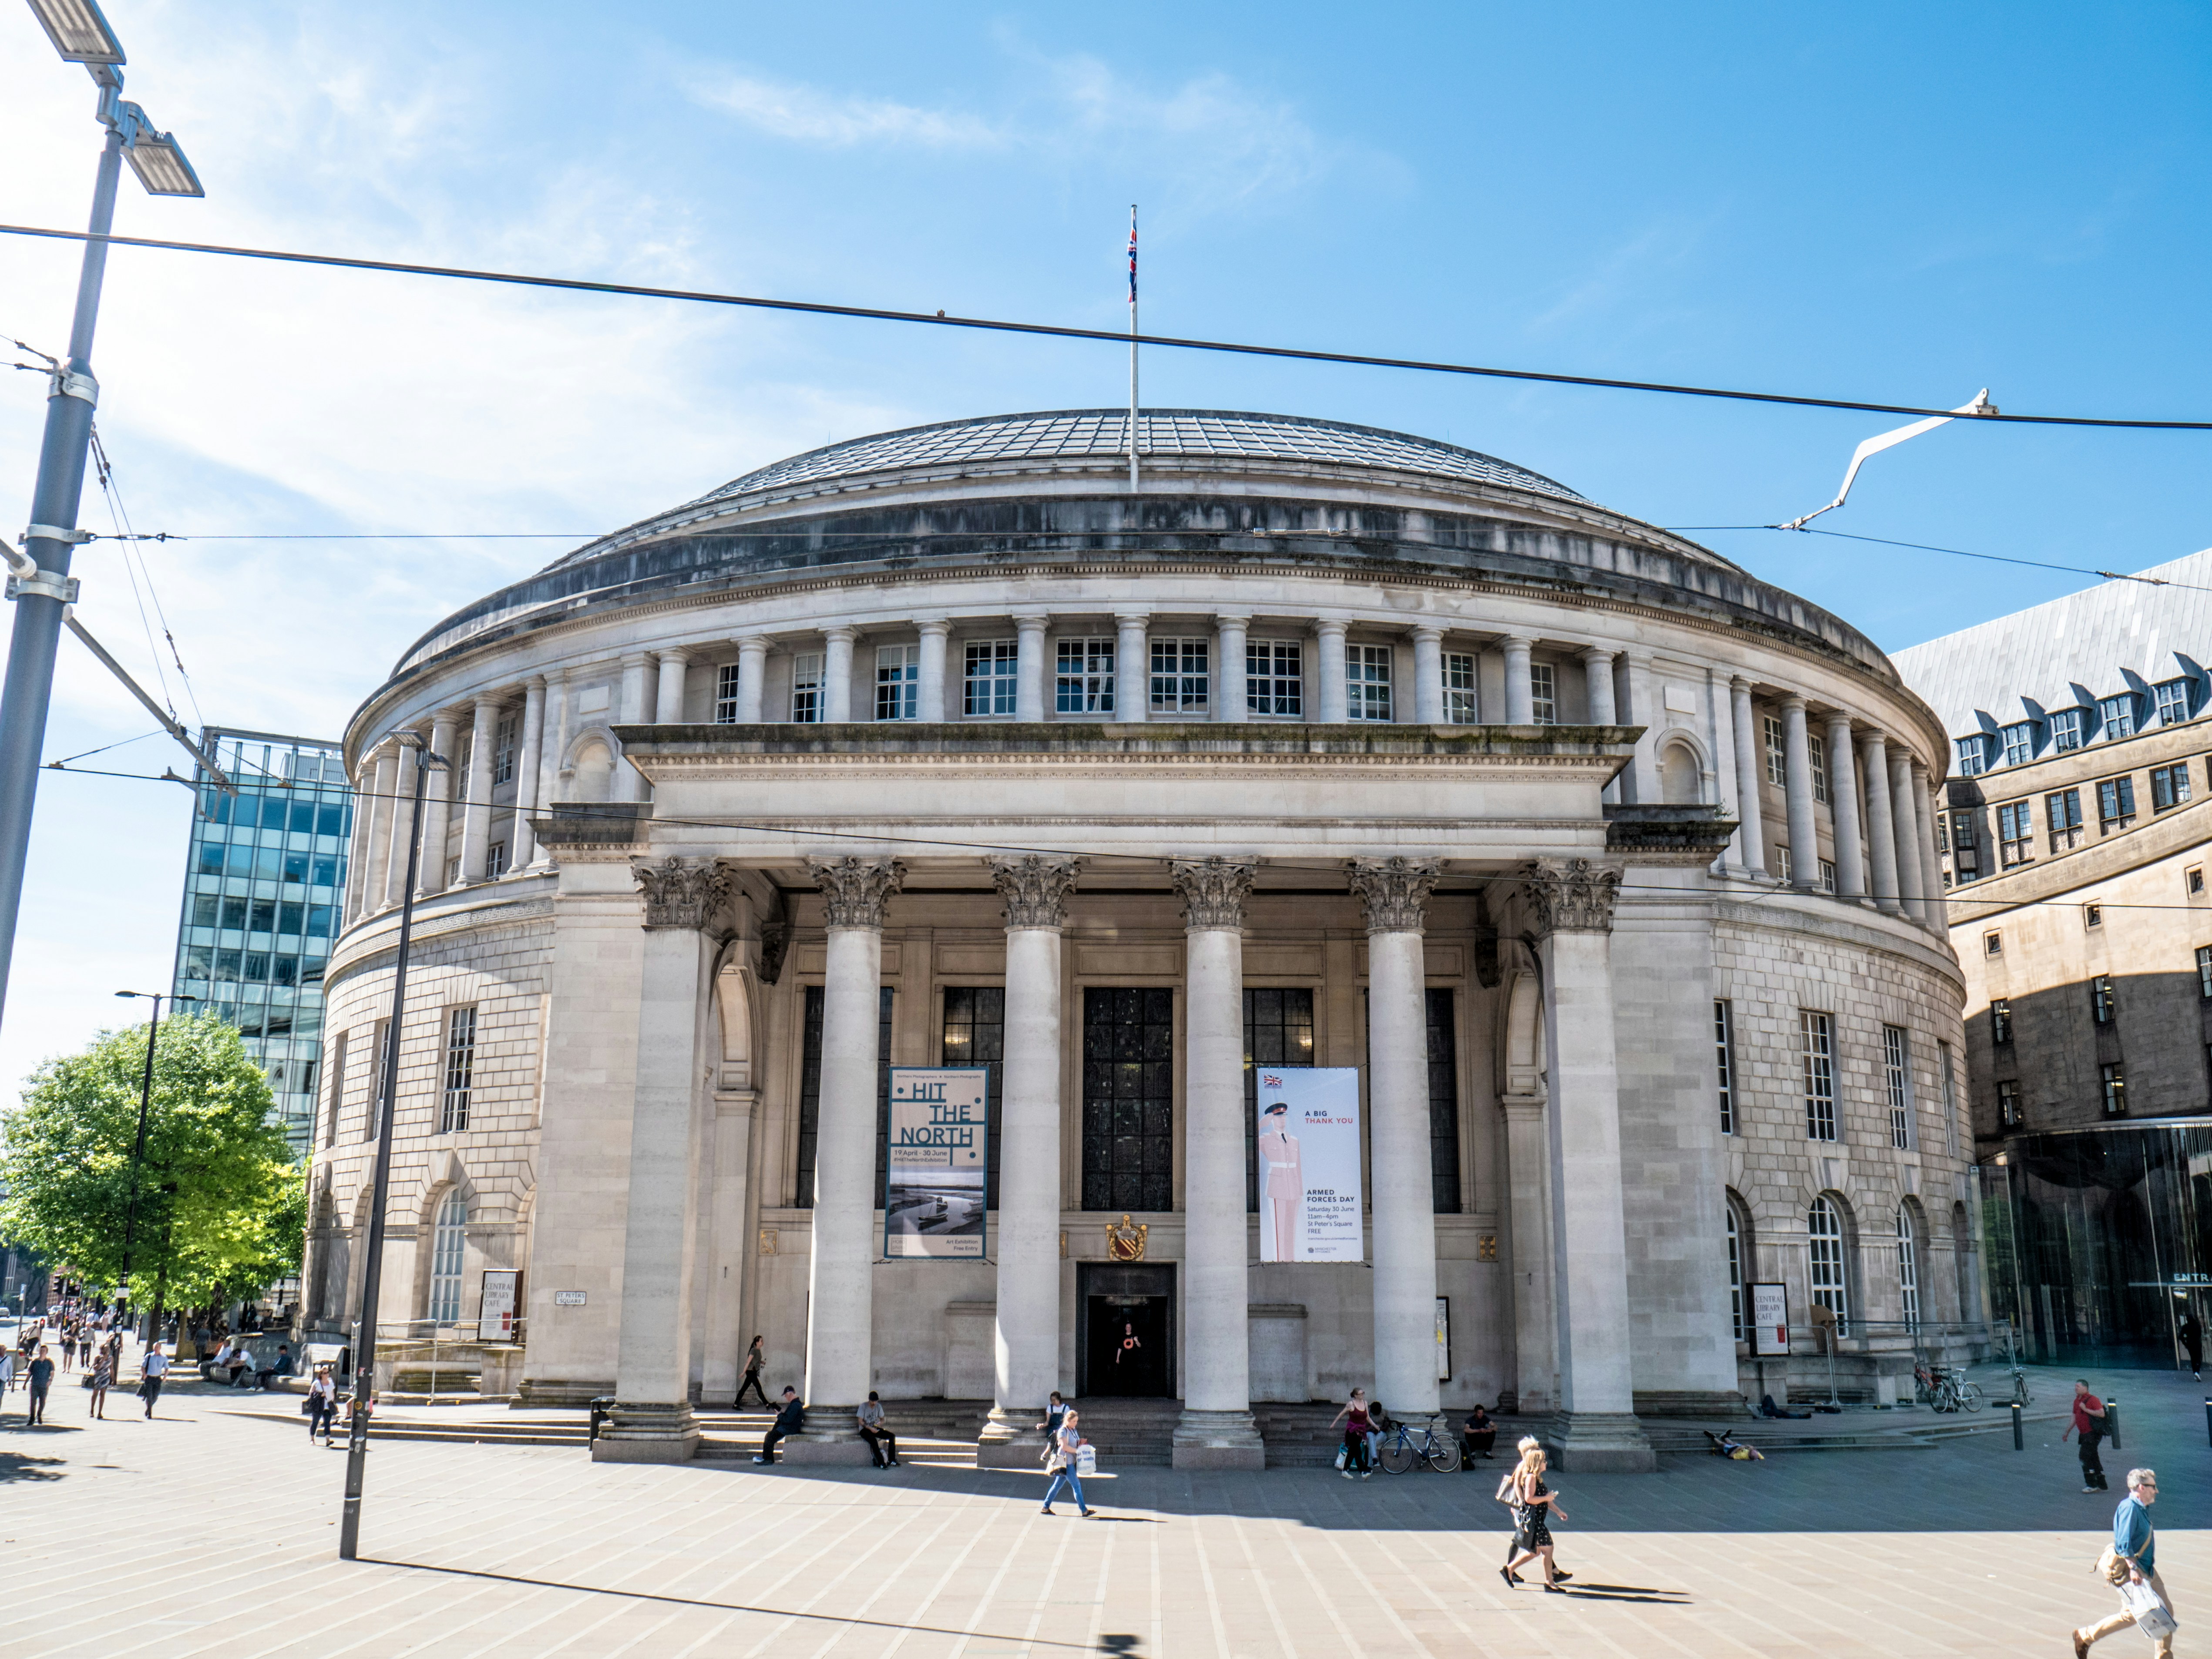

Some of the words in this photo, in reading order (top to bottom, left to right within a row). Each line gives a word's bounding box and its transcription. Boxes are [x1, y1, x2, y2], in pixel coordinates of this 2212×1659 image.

[913, 1083, 947, 1100] HIT
[929, 1105, 971, 1122] THE
[901, 1127, 973, 1145] NORTH
[2173, 1273, 2212, 1282] ENTR
